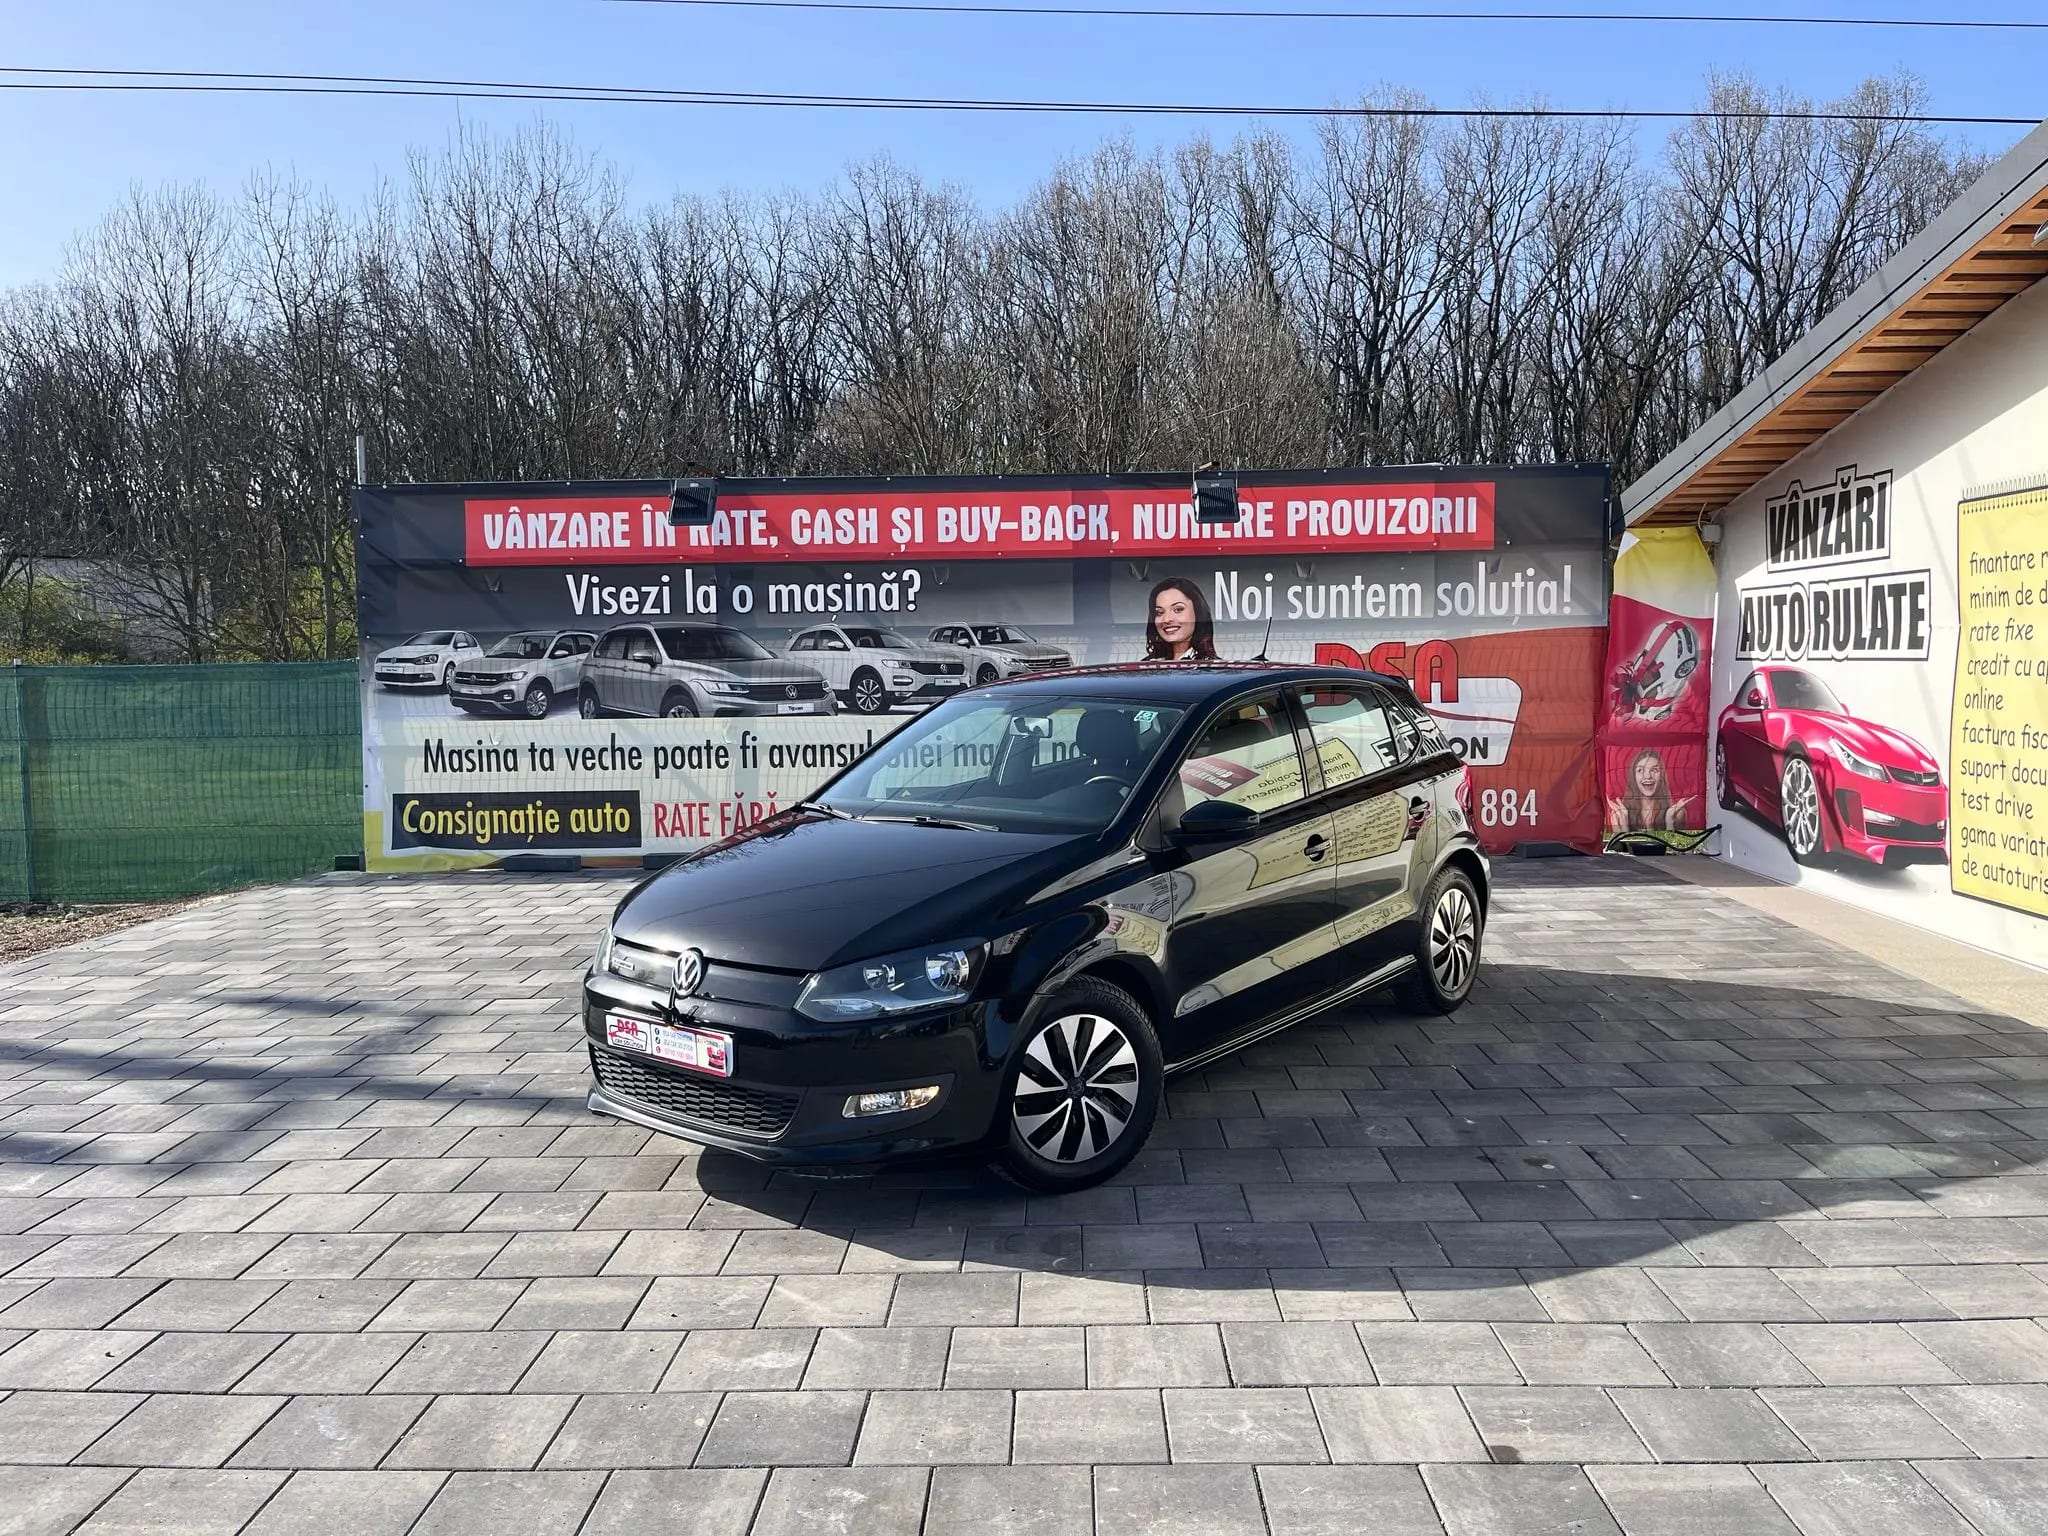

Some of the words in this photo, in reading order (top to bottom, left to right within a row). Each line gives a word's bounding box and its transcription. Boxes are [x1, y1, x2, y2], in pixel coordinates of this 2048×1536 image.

[483, 505, 630, 549] VÂNZARE
[641, 503, 676, 547] ÎN
[791, 507, 879, 545] CASH
[891, 507, 923, 553] ȘI
[937, 504, 1120, 544] BUY-BACK,
[1288, 496, 1477, 537] PROVIZORII
[1768, 475, 1887, 565] VÂNZĂRI
[1969, 551, 2036, 576] finantare
[566, 573, 670, 615] Visezi
[685, 569, 717, 614] la
[732, 583, 753, 613] o
[768, 568, 921, 621] mașină?
[1214, 570, 1273, 620] Noi
[1288, 575, 1422, 620] suntem
[1437, 561, 1572, 625] soluția!
[1970, 585, 2010, 609] minim
[2015, 581, 2034, 606] de
[1739, 591, 1805, 653] AUTO
[1812, 581, 1925, 652] RULATE
[1969, 621, 1999, 642] rate
[2005, 617, 2034, 643] fixe
[1967, 652, 2010, 676] credit
[2014, 659, 2032, 677] cu
[1964, 686, 2004, 711] online
[1962, 719, 2016, 747] factura
[528, 742, 555, 771] ta
[565, 733, 642, 771] veche
[654, 740, 730, 778] poate
[740, 731, 758, 769] fi
[1960, 758, 2007, 784] suport
[2011, 758, 2047, 786] docu
[654, 802, 711, 838] RATE
[1481, 788, 1538, 827] 884
[1961, 788, 1990, 813] test
[1995, 791, 2034, 820] drive
[402, 799, 560, 844] Consignație
[570, 803, 631, 834] auto
[1961, 826, 1996, 848] gama
[1961, 852, 1979, 877] de
